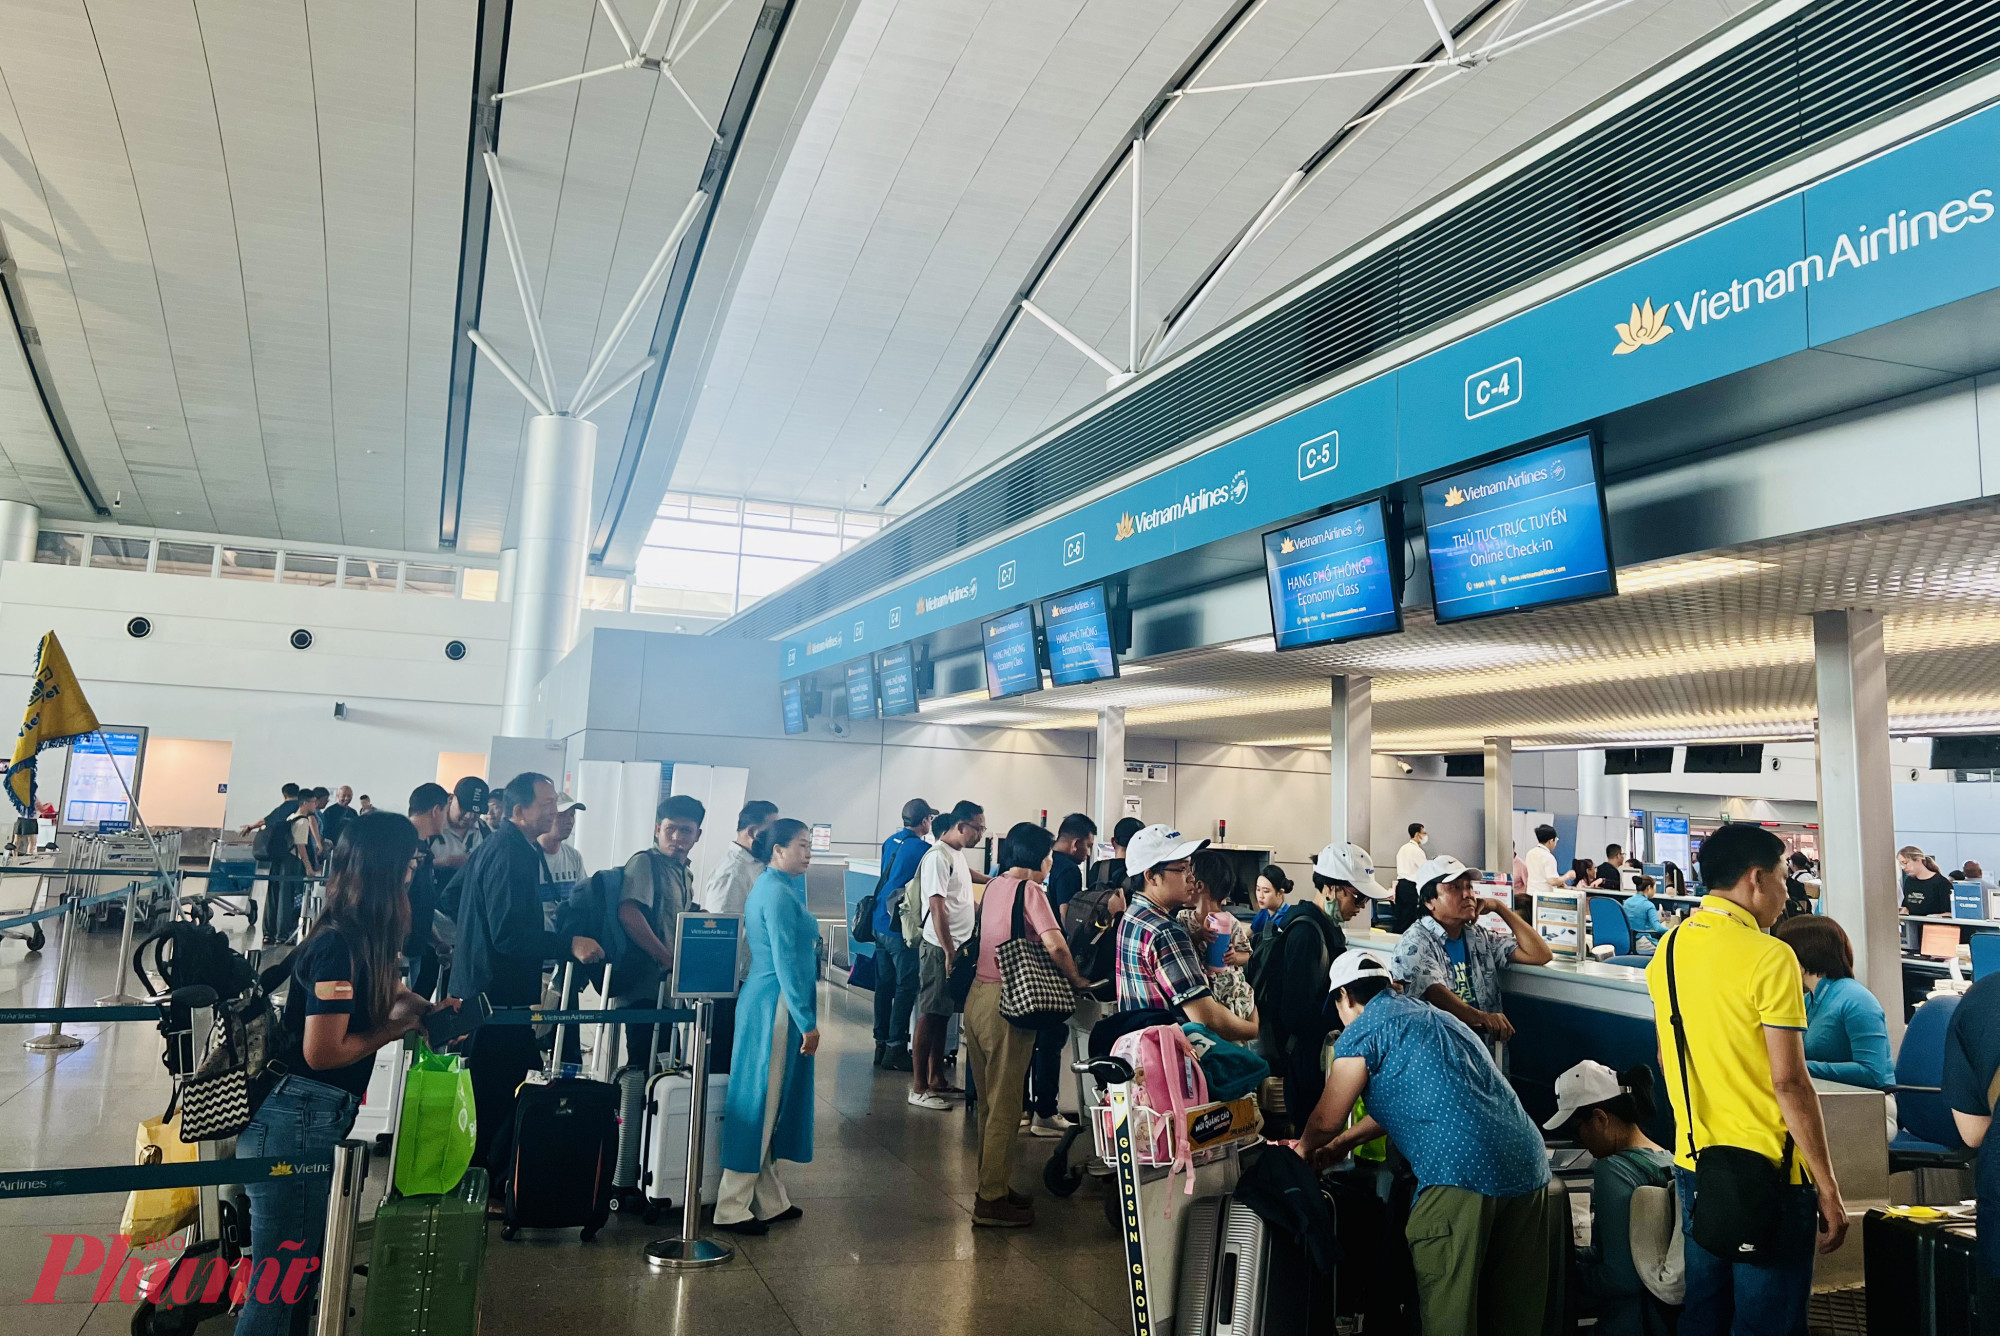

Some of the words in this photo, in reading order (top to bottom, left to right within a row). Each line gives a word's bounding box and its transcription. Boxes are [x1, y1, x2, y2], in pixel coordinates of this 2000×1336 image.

[1476, 372, 1510, 405] C-4
[1306, 442, 1330, 469] C-5
[1528, 506, 1568, 531] TUYẾN
[1067, 540, 1081, 558] C-6
[1470, 549, 1504, 567] Online
[1505, 537, 1554, 559] Check-in
[1001, 567, 1013, 583] C-7
[1287, 572, 1312, 592] HẠNG
[1332, 559, 1367, 580] THÔNG
[1297, 588, 1336, 606] Economy
[1336, 582, 1360, 597] Class
[1119, 1137, 1139, 1243] GOLDSUN
